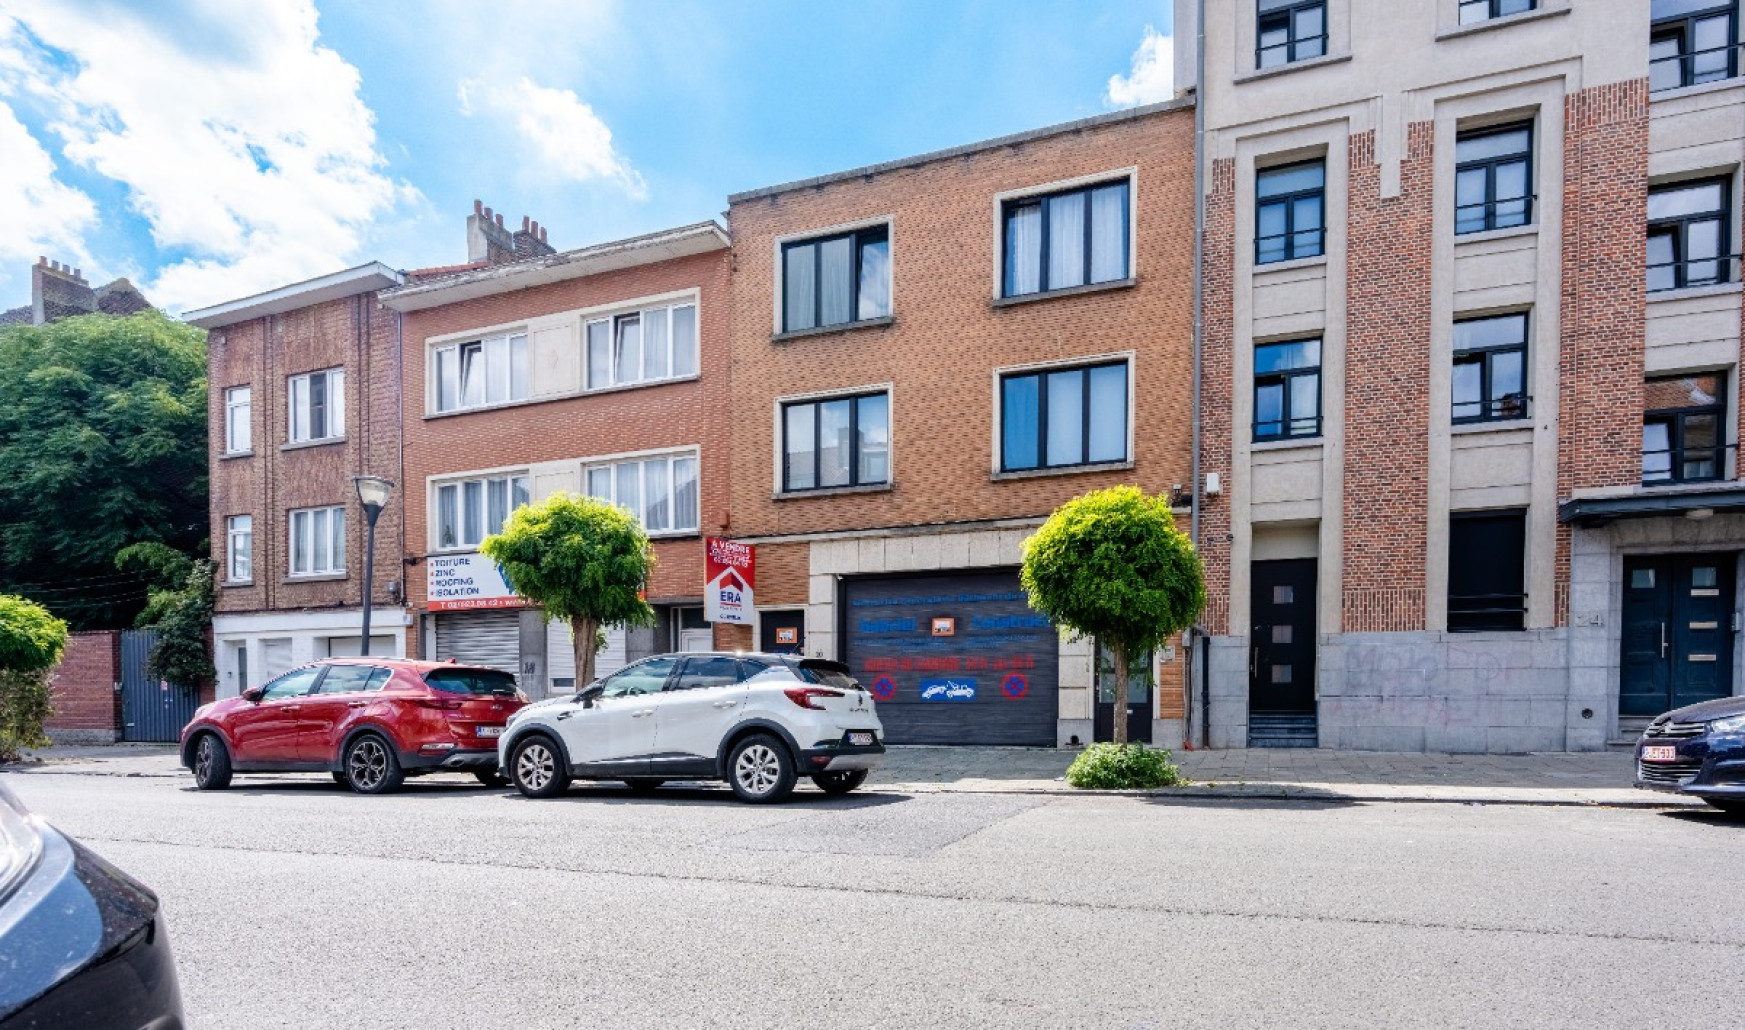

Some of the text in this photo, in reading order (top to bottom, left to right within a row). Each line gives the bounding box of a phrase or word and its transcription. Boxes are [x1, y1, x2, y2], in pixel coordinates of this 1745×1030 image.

[435, 558, 470, 567] TOITURE
[435, 569, 455, 577] ZINC
[720, 591, 741, 602] ERA
